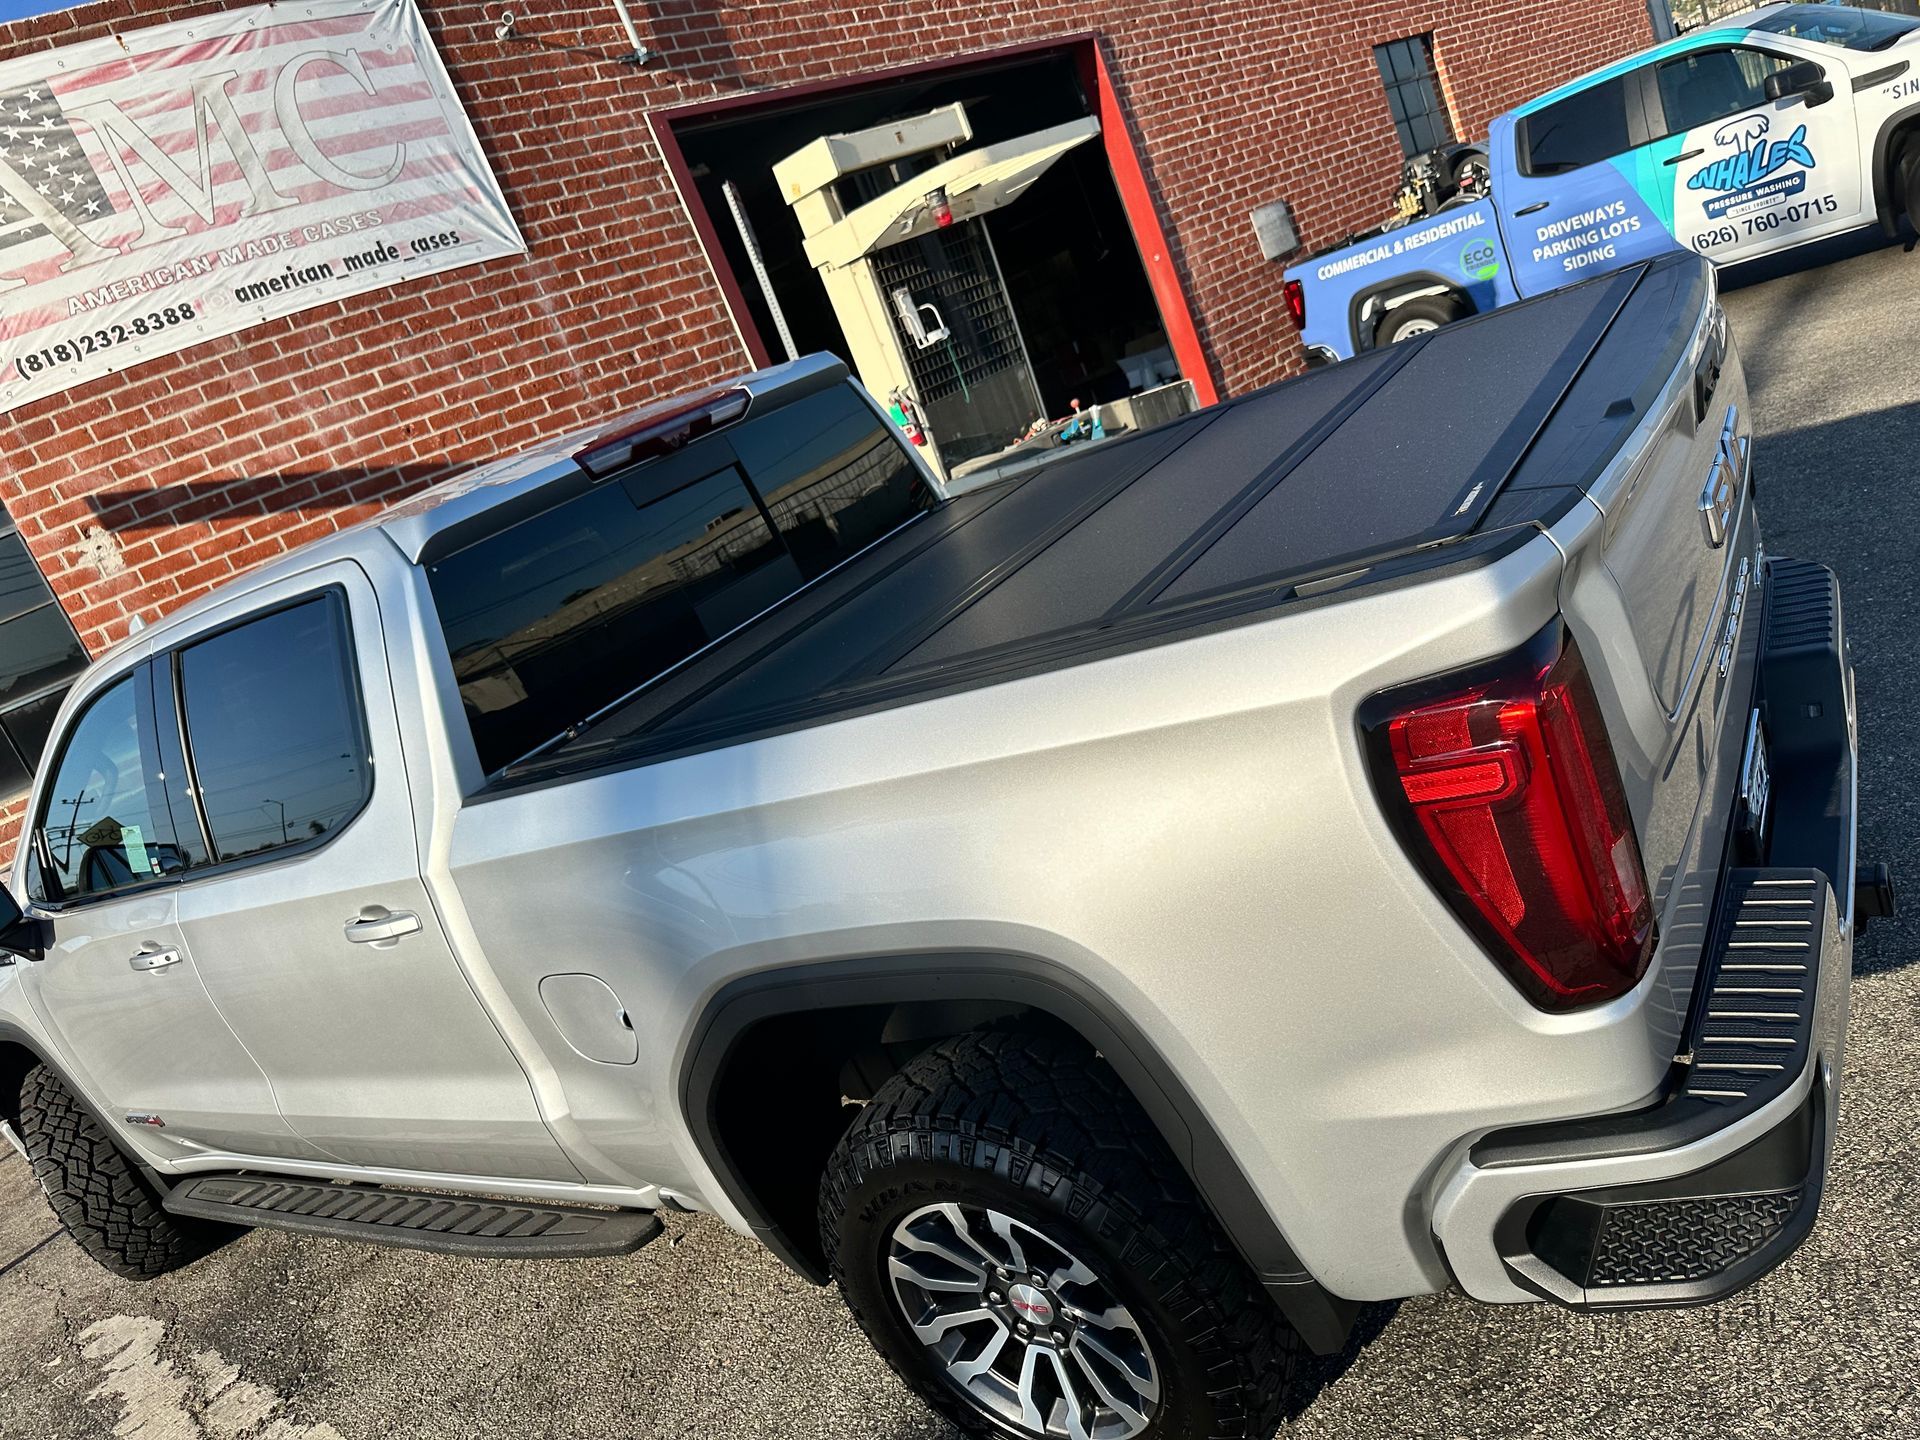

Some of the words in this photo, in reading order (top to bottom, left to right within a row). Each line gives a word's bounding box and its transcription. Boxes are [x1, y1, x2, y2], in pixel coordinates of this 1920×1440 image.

[1687, 124, 1816, 191] WHALES
[1536, 200, 1626, 242] DRIVEWAYS
[1708, 191, 1753, 212] PRESSURE
[1755, 177, 1801, 196] WASHING
[1317, 245, 1393, 281] COMMERCIAL
[1393, 240, 1404, 255] &
[1405, 211, 1486, 251] RESIDENTIAL
[1532, 230, 1599, 262] PARKING
[1600, 215, 1641, 240] LOTS
[1691, 225, 1739, 253] (626)
[1742, 194, 1838, 236] 760-0715
[67, 254, 214, 316] AMERICAN
[221, 231, 298, 268] MADE
[301, 210, 384, 244] CASES
[234, 229, 461, 303] american_made_cases
[1464, 246, 1494, 265] ECO
[1466, 256, 1496, 272] FRIENDLY
[1563, 244, 1616, 272] SIDING
[15, 302, 196, 381] (818)232-8388
